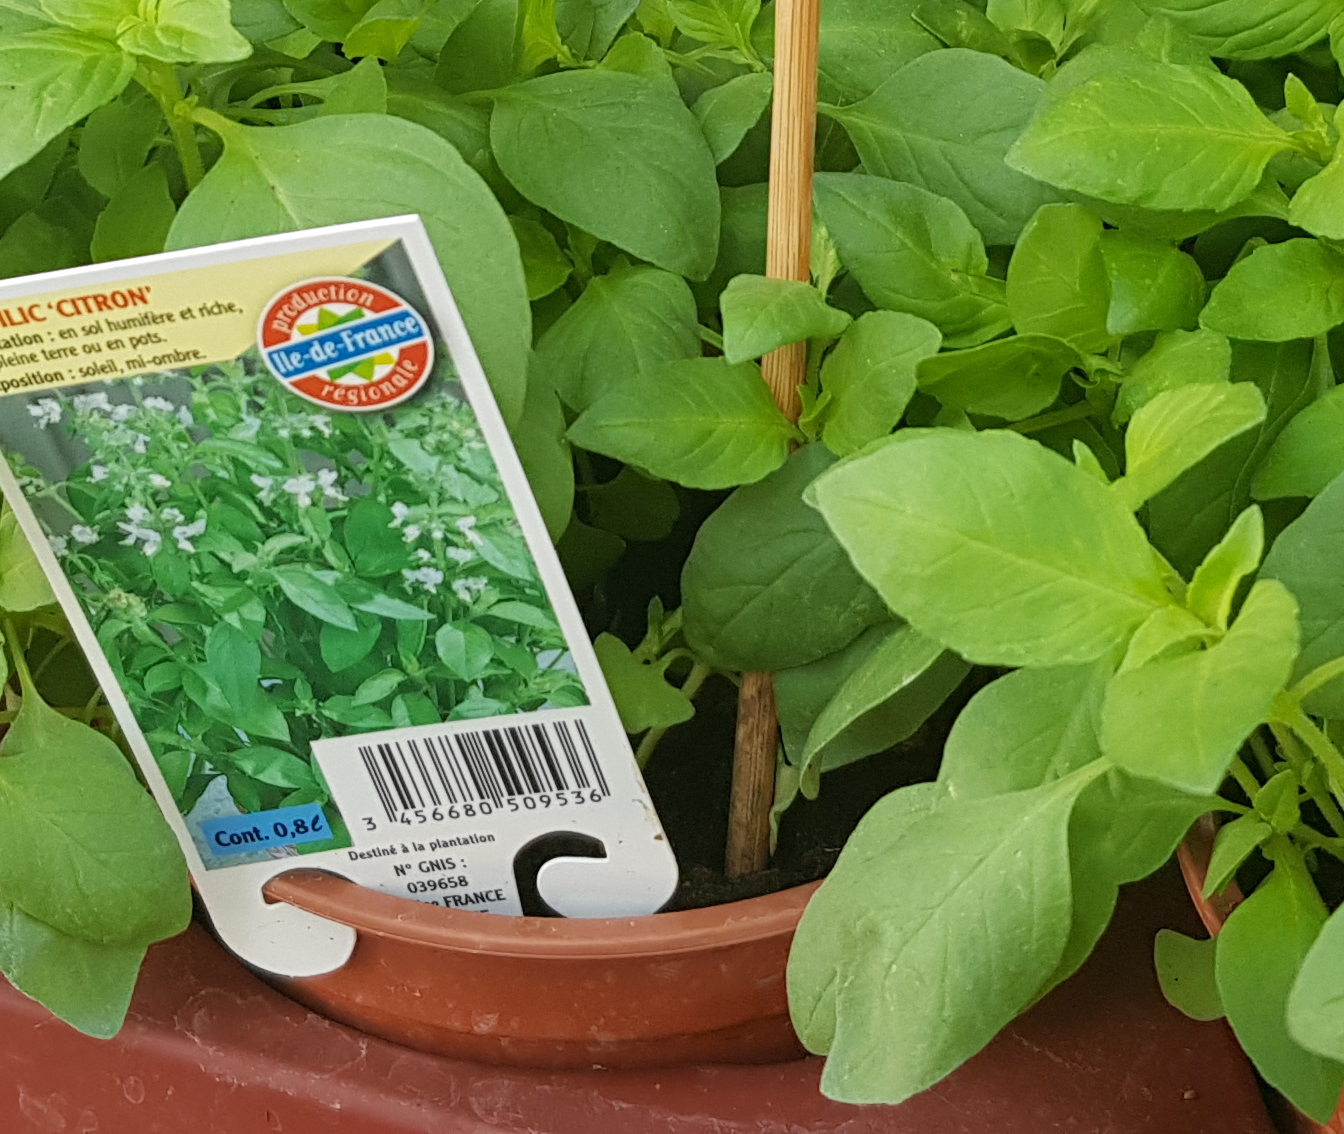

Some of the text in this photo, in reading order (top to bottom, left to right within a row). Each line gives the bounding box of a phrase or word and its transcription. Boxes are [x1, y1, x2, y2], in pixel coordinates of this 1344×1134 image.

[58, 326, 78, 340] en
[81, 319, 104, 336] sol
[104, 310, 176, 333] humifère
[179, 307, 196, 320] et
[198, 299, 244, 318] riche,
[271, 284, 375, 334] production
[41, 345, 80, 361] terre
[82, 341, 102, 355] ou
[106, 337, 126, 351] en
[128, 331, 168, 350] pots.
[271, 315, 420, 374] Ile-de-France
[78, 358, 125, 378] soleil,
[125, 348, 207, 371] mi-ombre.
[321, 358, 418, 405] régionale
[361, 788, 603, 831] 3 456680 509536
[214, 826, 270, 847] Cont.
[348, 833, 496, 861] Destiné à la plantation
[418, 857, 457, 874] GNIS
[407, 875, 469, 894] 039658
[443, 888, 507, 908] FRANCE
